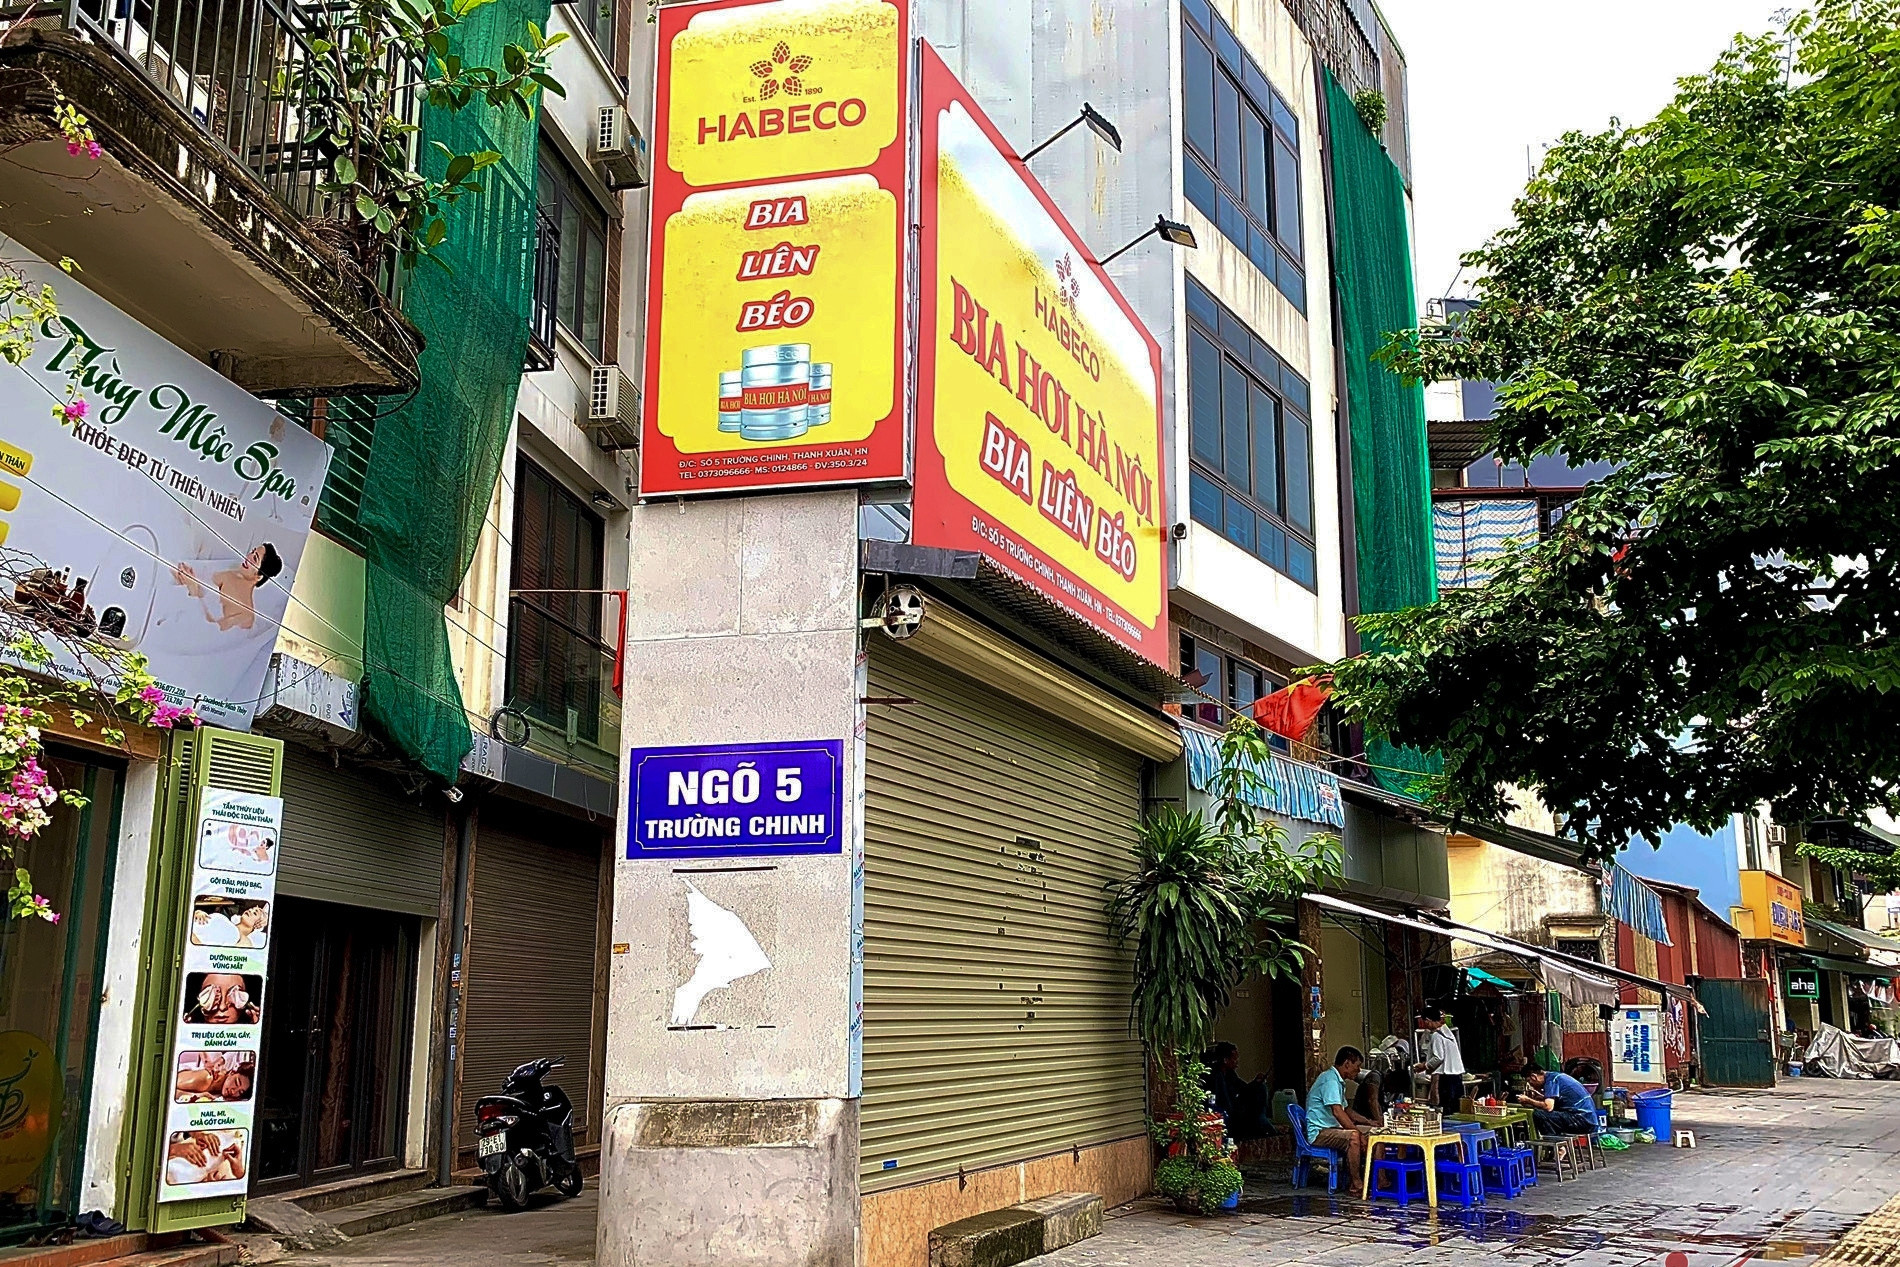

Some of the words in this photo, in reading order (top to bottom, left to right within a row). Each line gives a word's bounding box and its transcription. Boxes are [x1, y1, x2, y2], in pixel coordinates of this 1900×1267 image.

[697, 98, 867, 145] HABECO
[746, 198, 807, 228] BIA
[739, 244, 817, 279] LIÊN
[739, 292, 812, 330] BÉO
[1035, 286, 1100, 382] HABECO
[41, 316, 143, 424] Thùy
[149, 384, 233, 462] Mộc
[234, 441, 297, 501] Spa
[744, 393, 757, 405] BIA
[950, 275, 1012, 394] BIA
[1015, 341, 1071, 448] HƠI
[1075, 402, 1113, 489] HÀ
[1114, 441, 1154, 527] NỘI
[72, 422, 118, 456] KHỎE
[117, 442, 148, 470] ĐẸP
[149, 458, 168, 481] TỪ
[170, 469, 206, 502] THIÊN
[209, 489, 247, 522] NHIÊN
[679, 471, 696, 479] TEL:
[755, 465, 770, 474] MS:
[760, 452, 790, 463] CHINH,
[793, 450, 824, 461] THANH
[855, 447, 868, 455] HN
[982, 417, 1031, 500] BIA
[1039, 468, 1092, 545] LIÊN
[1097, 513, 1135, 577] BÉO
[1000, 538, 1005, 549] 5
[1056, 572, 1076, 597] THANH
[668, 761, 760, 806] NGÕ
[775, 767, 803, 802] 5
[645, 813, 741, 839] TRƯỜNG
[749, 814, 825, 836] CHINH
[1791, 978, 1815, 990] aha
